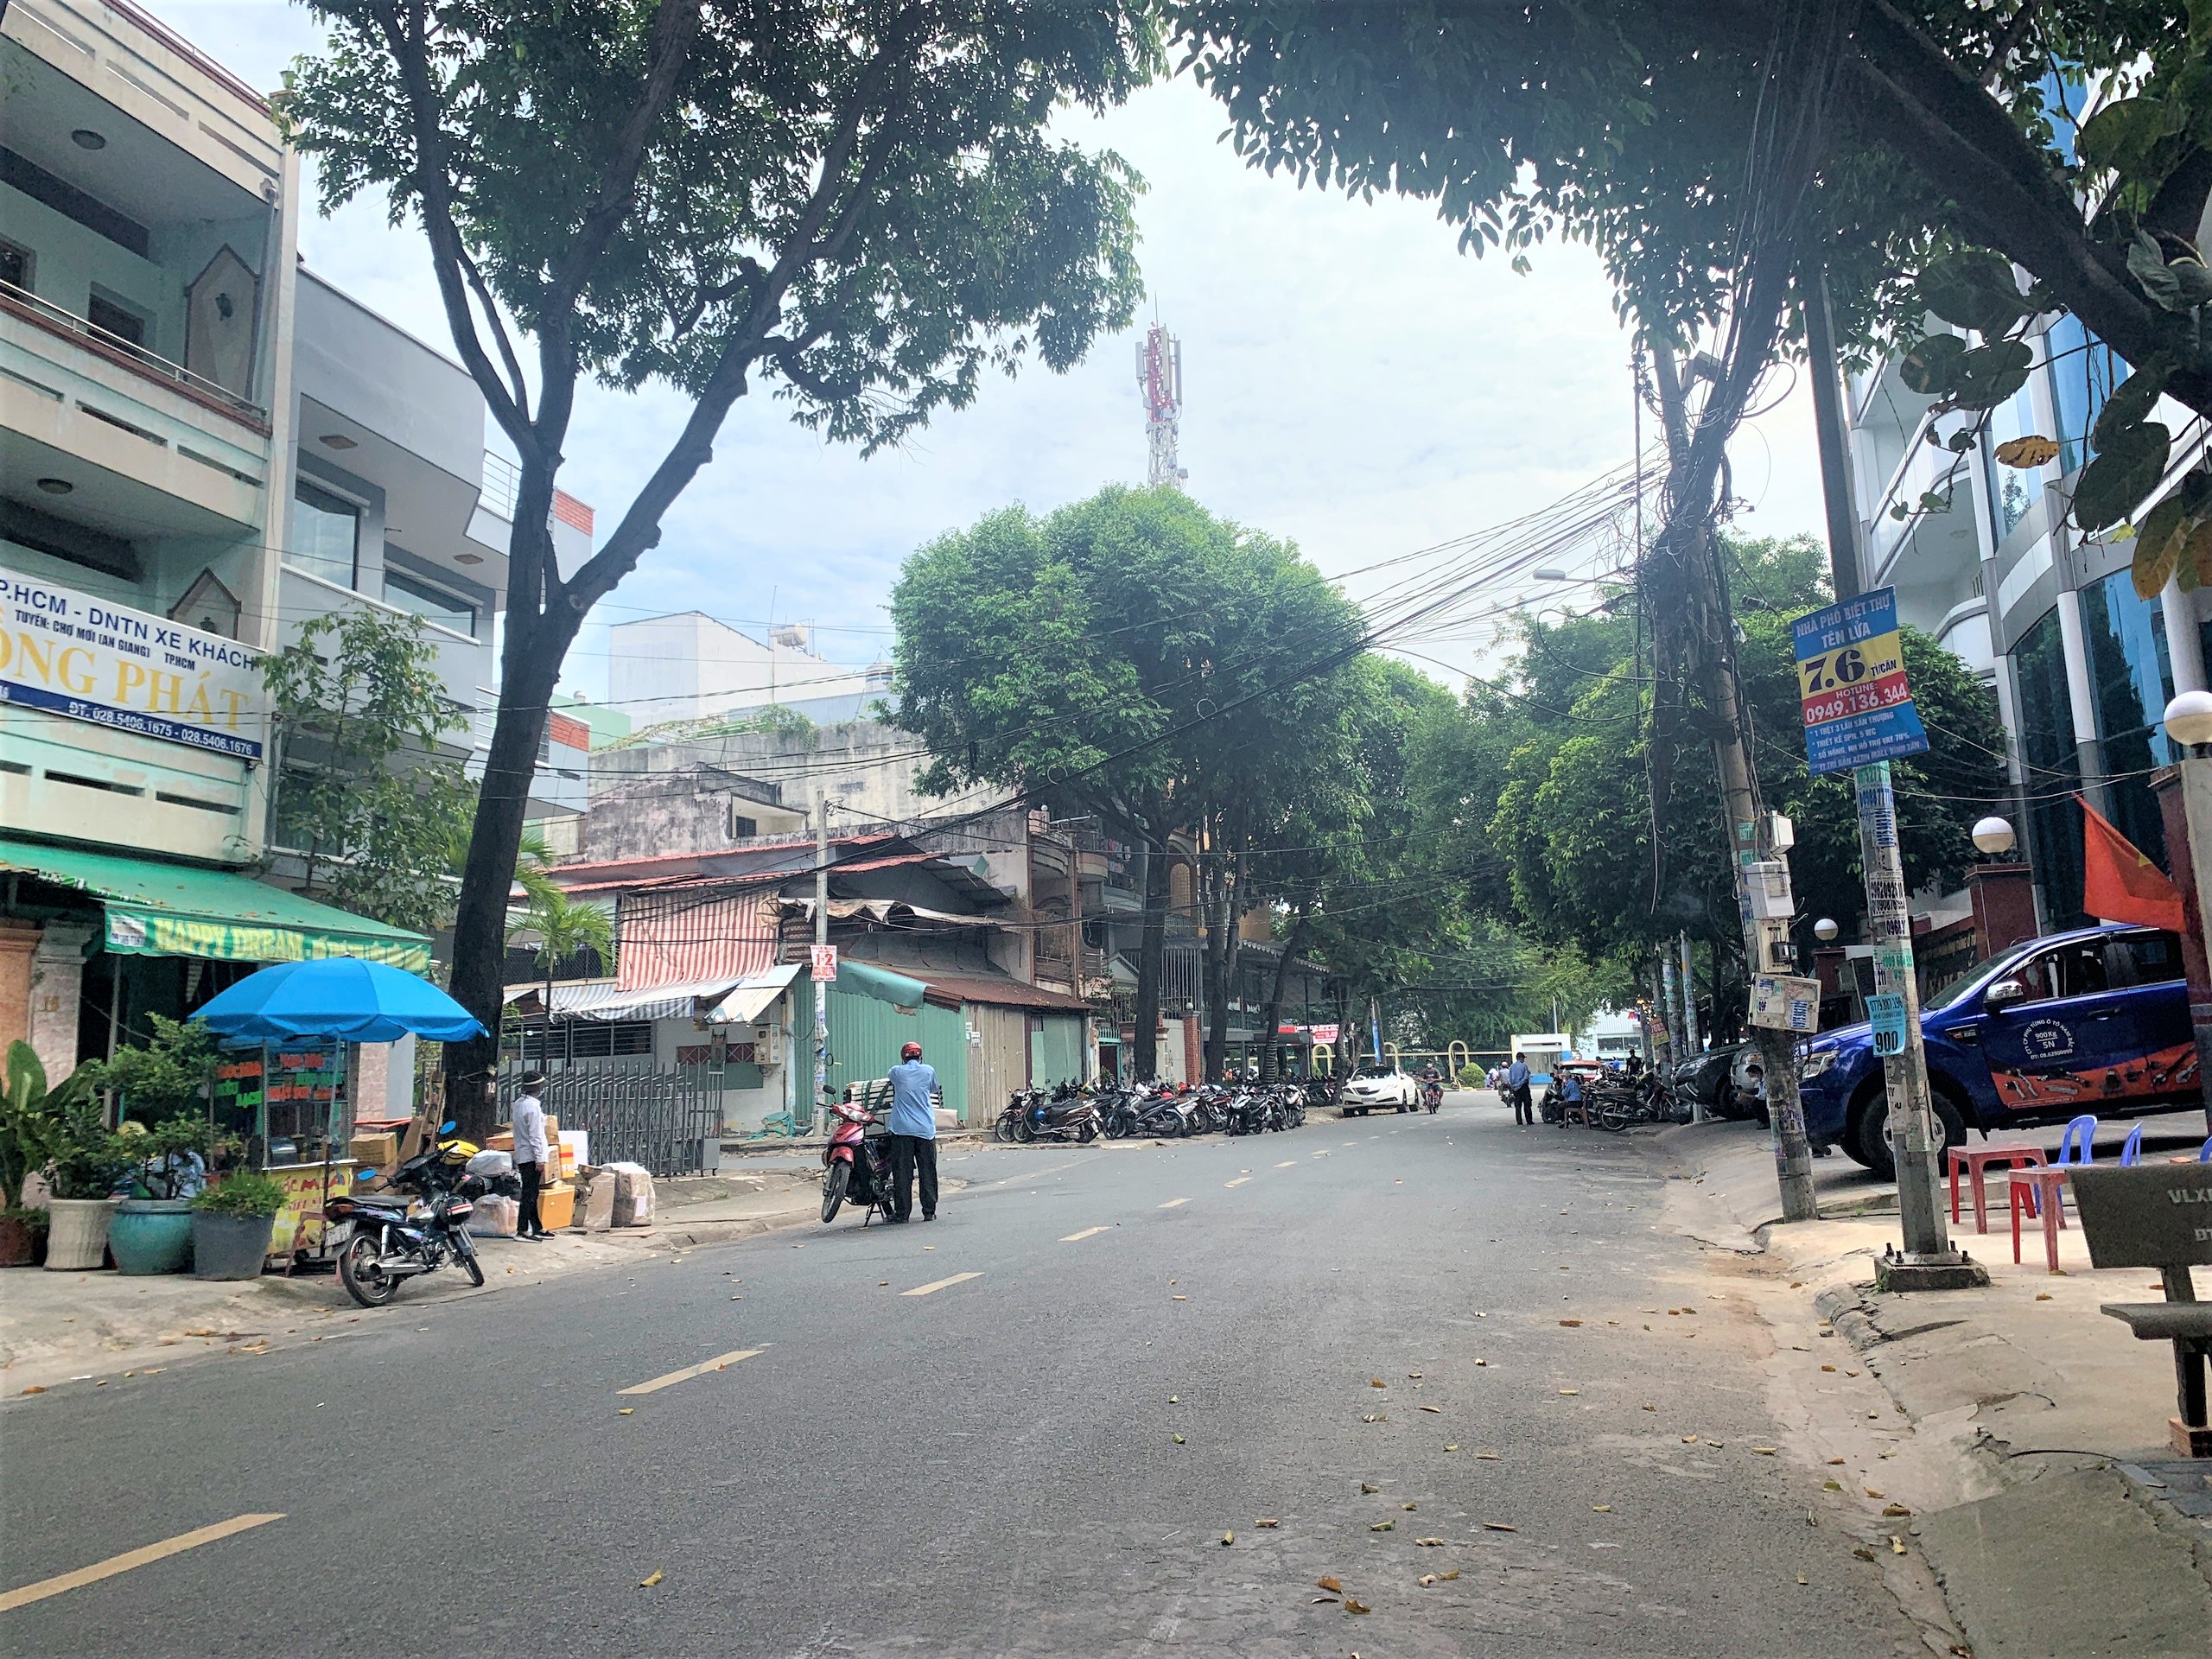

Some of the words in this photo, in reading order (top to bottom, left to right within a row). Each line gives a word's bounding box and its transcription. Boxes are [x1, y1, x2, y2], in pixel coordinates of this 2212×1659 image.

[1796, 617, 1819, 638] NHÀ
[1844, 601, 1866, 620] BIỆT
[1869, 594, 1890, 612] THỰ
[89, 607, 148, 639] DNTN
[155, 627, 181, 650] XE
[188, 637, 255, 671] KHÁCH
[1821, 631, 1846, 649] TÊN
[1804, 649, 1866, 693] 7.6
[111, 658, 250, 733] PHÁT
[1806, 683, 1907, 723] 0949.136.344
[1836, 682, 1878, 698] HOTLINE:
[181, 728, 252, 756] 028.5406.1676
[154, 918, 227, 957] HAPPY
[231, 926, 304, 961] DREAM
[1875, 1031, 1898, 1053] 900
[2042, 1040, 2056, 1049] 5N
[486, 1082, 496, 1093] 12
